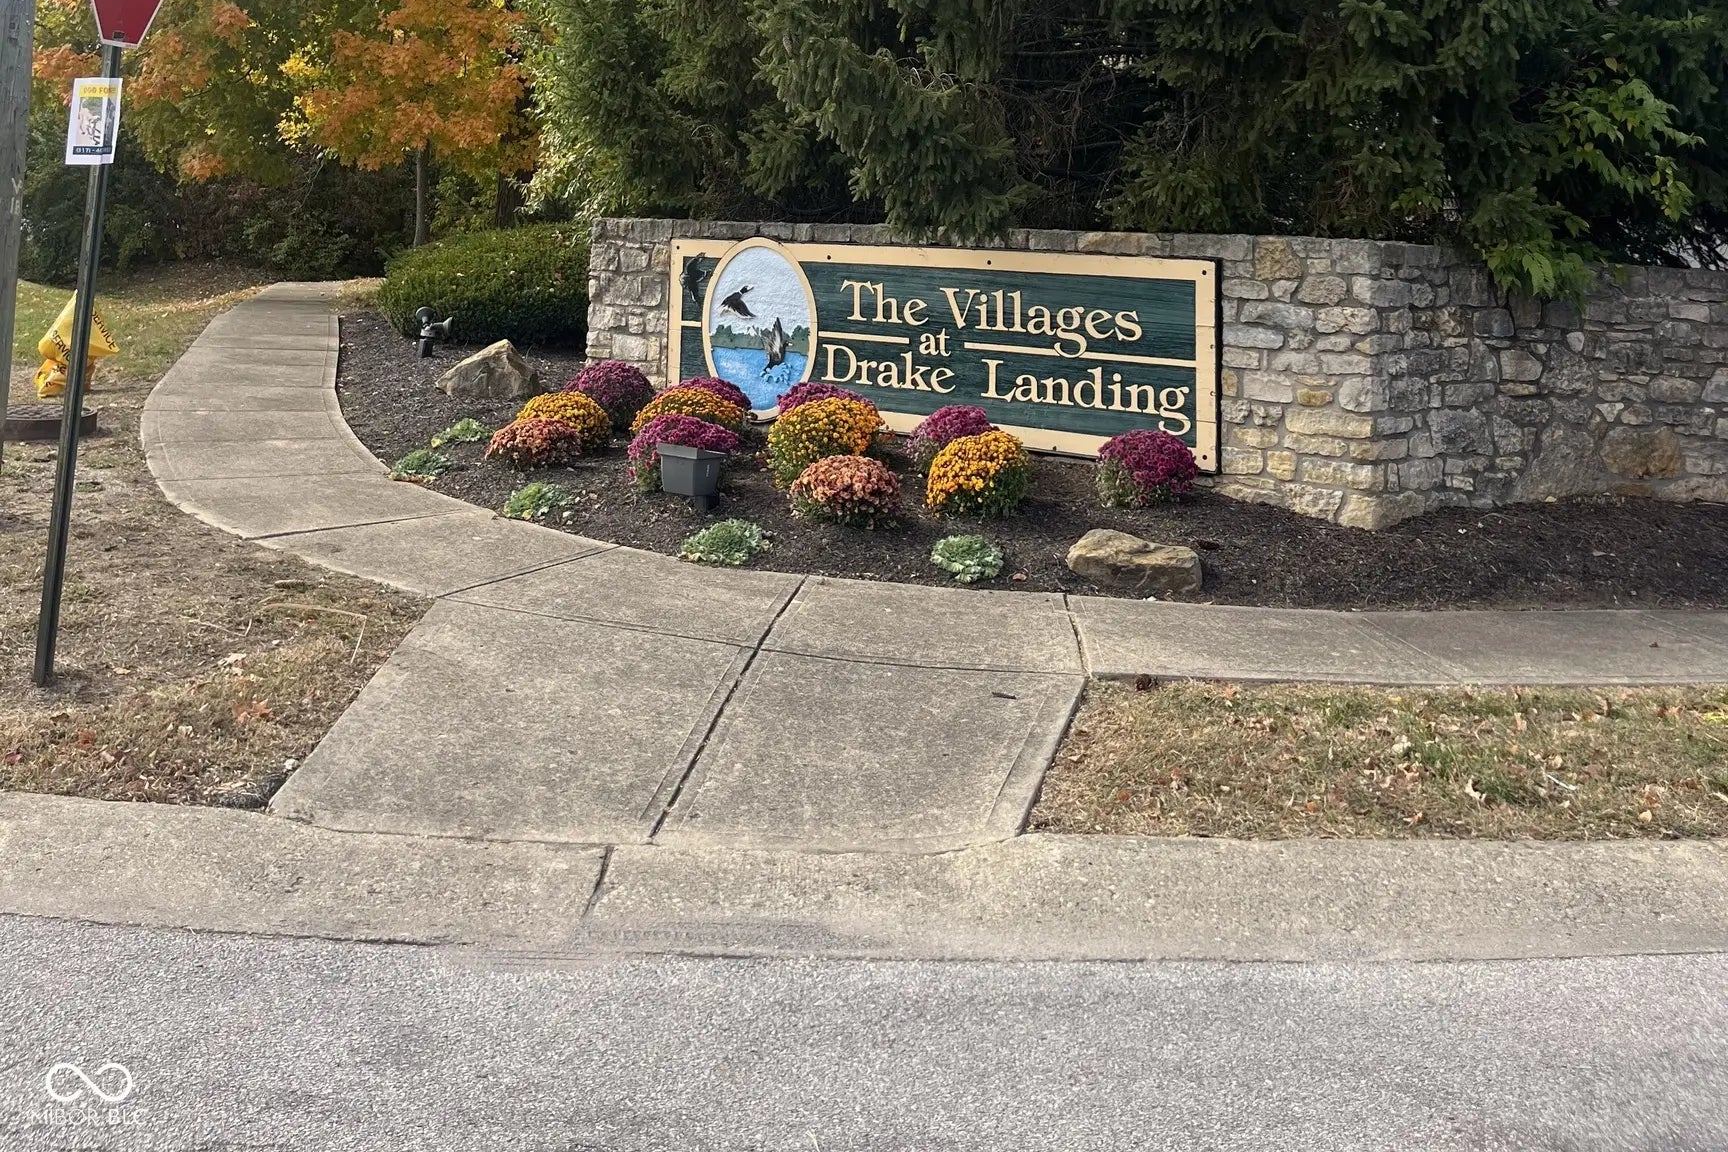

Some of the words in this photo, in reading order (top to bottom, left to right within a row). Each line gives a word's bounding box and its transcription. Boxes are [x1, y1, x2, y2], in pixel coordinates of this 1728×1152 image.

[51, 330, 71, 361] SERVIC
[840, 279, 929, 326] The
[939, 286, 1143, 358] Villages
[918, 328, 952, 357] at
[821, 343, 956, 394] Drake
[981, 359, 1192, 437] Landing
